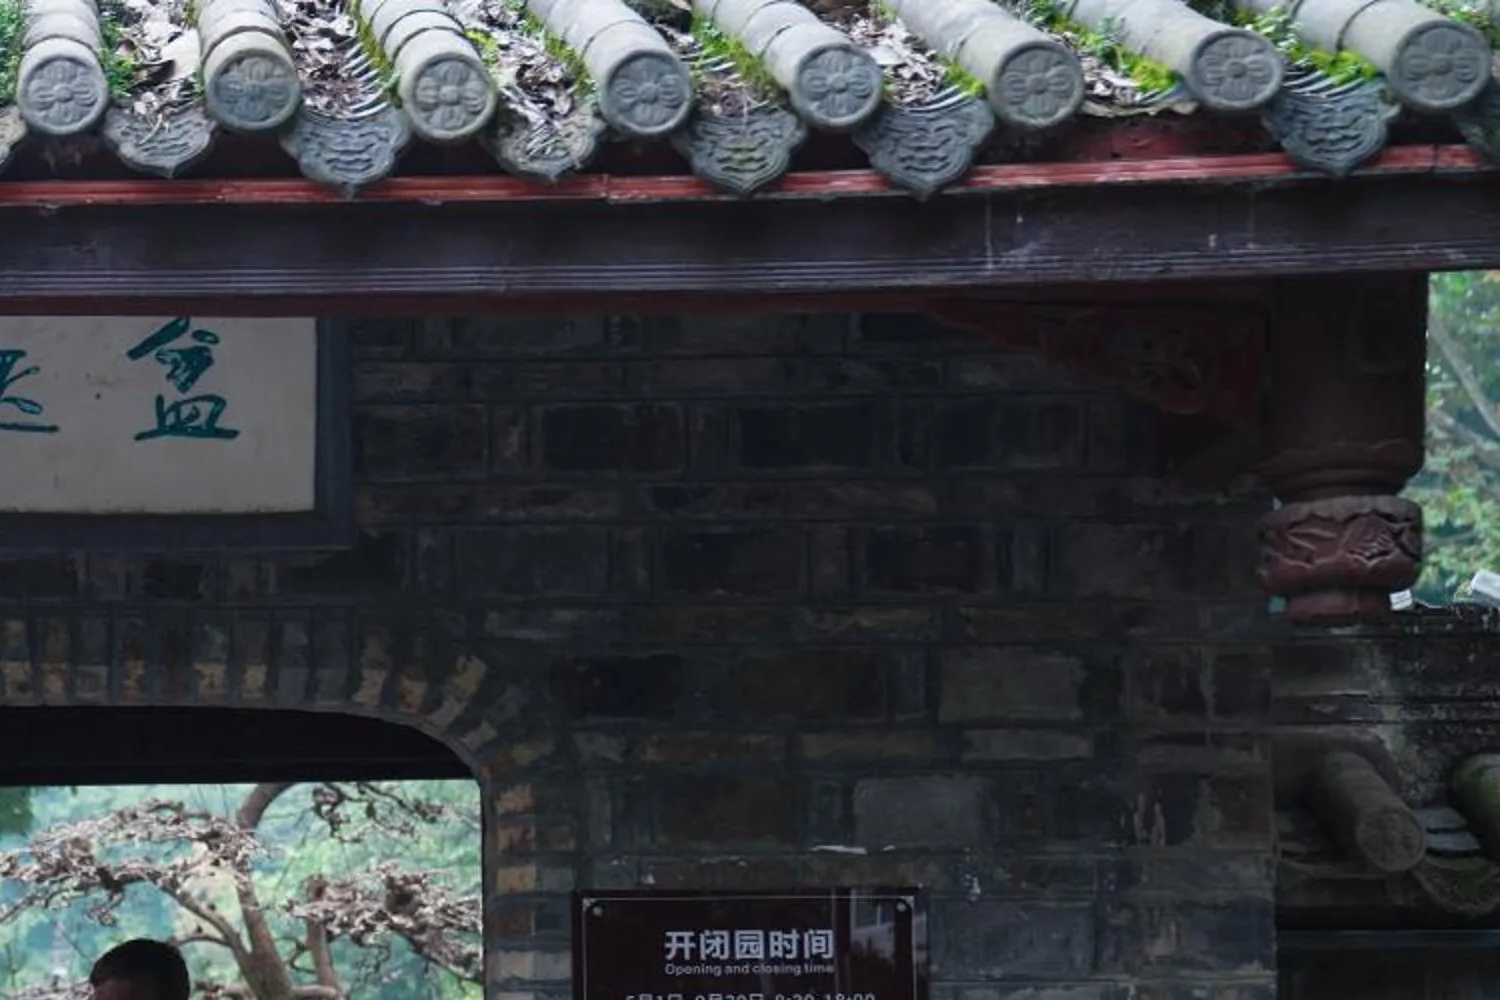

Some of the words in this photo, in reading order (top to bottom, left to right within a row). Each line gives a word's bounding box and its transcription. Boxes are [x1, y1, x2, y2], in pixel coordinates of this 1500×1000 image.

[664, 929, 835, 960] 开闭园时间
[664, 963, 722, 977] Opening
[724, 963, 750, 974] and
[752, 963, 801, 977] closing
[804, 962, 835, 974] time
